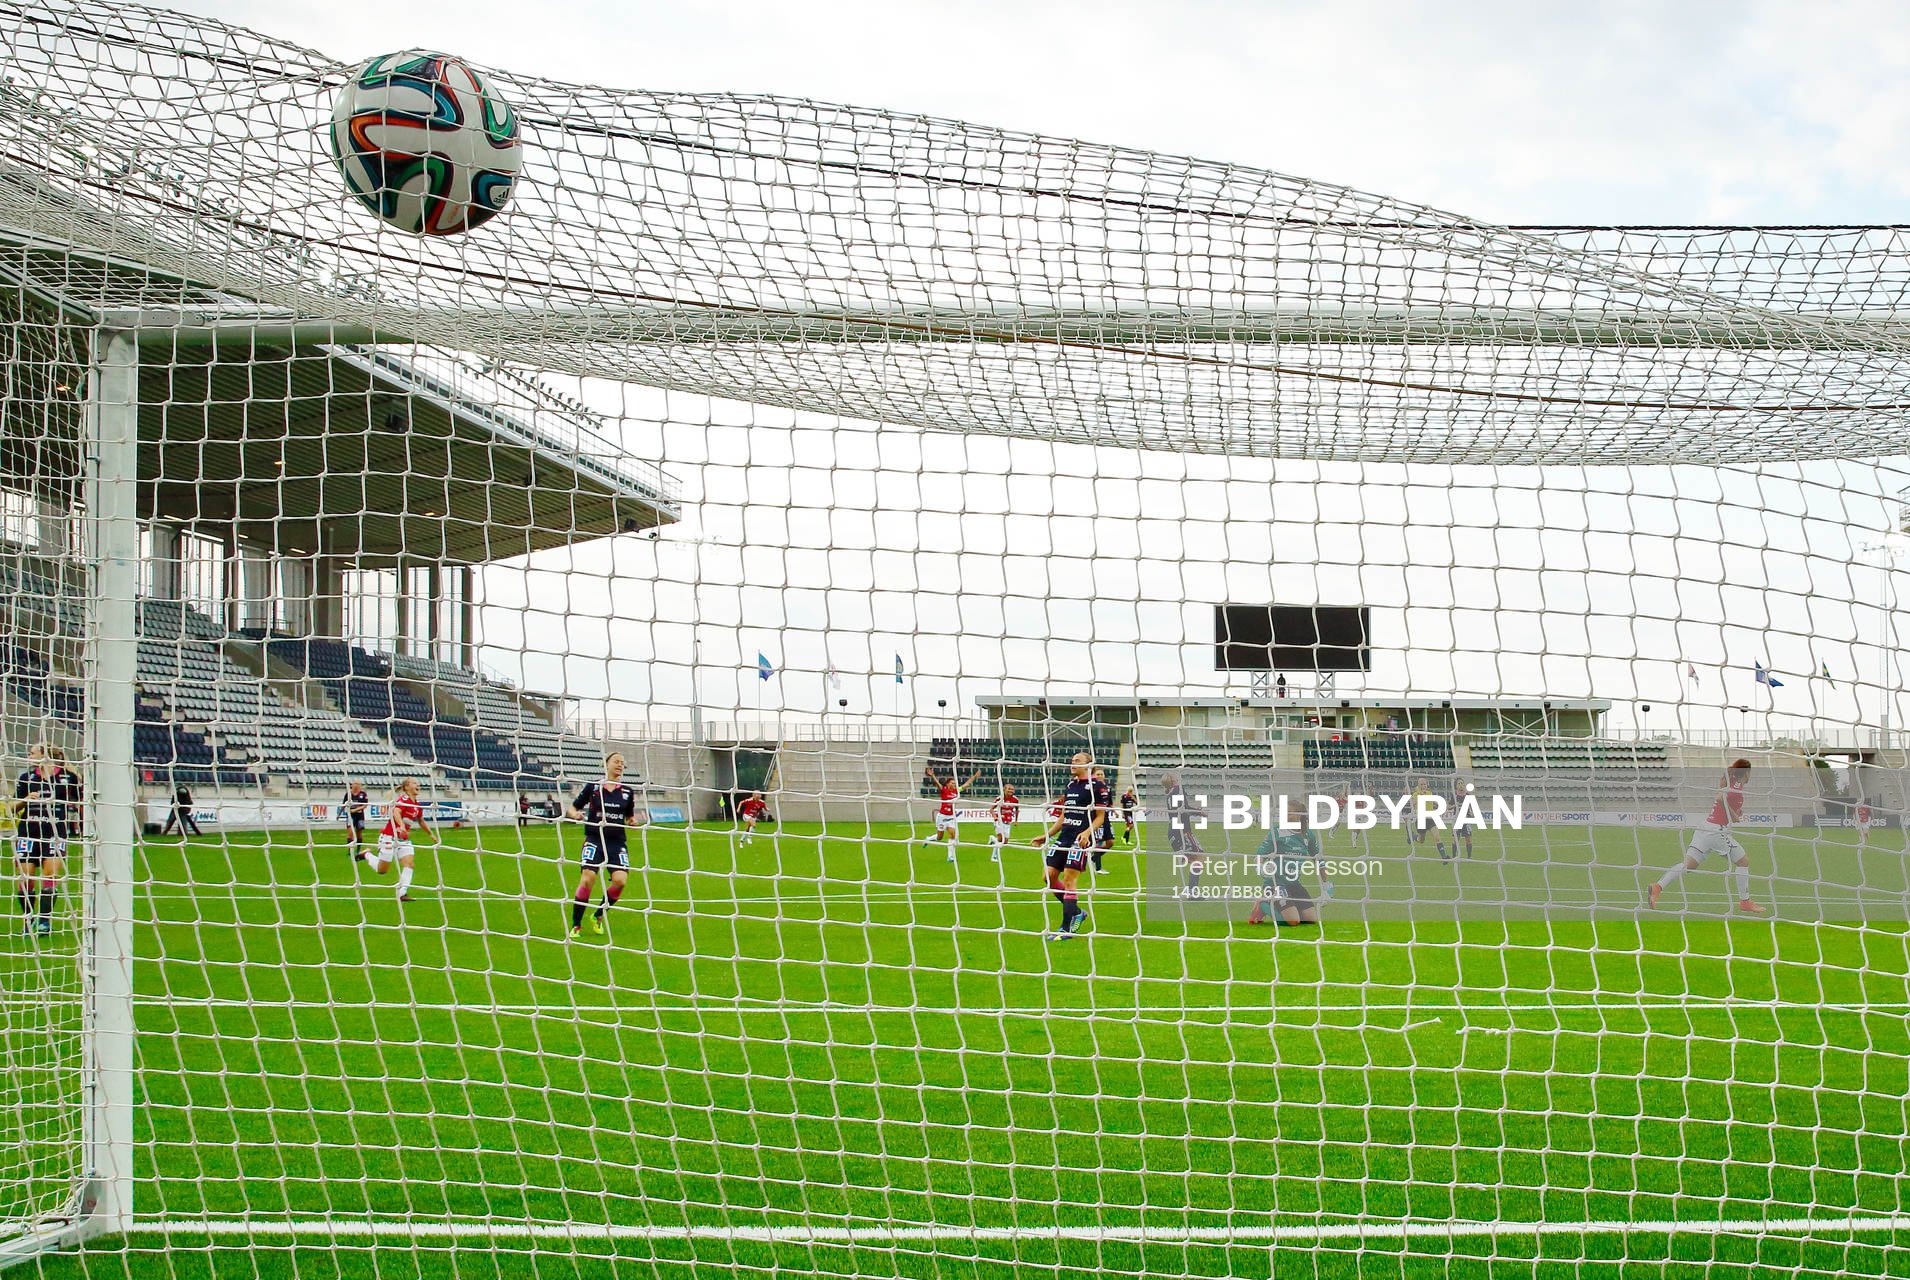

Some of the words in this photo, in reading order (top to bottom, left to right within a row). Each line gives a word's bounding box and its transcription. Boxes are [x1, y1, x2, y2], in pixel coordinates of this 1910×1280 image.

[1534, 813, 1590, 821] INTERSPORT
[1628, 814, 1683, 822] INTERSPORT
[1739, 815, 1777, 823] ERSPORT
[1843, 817, 1887, 827] adas
